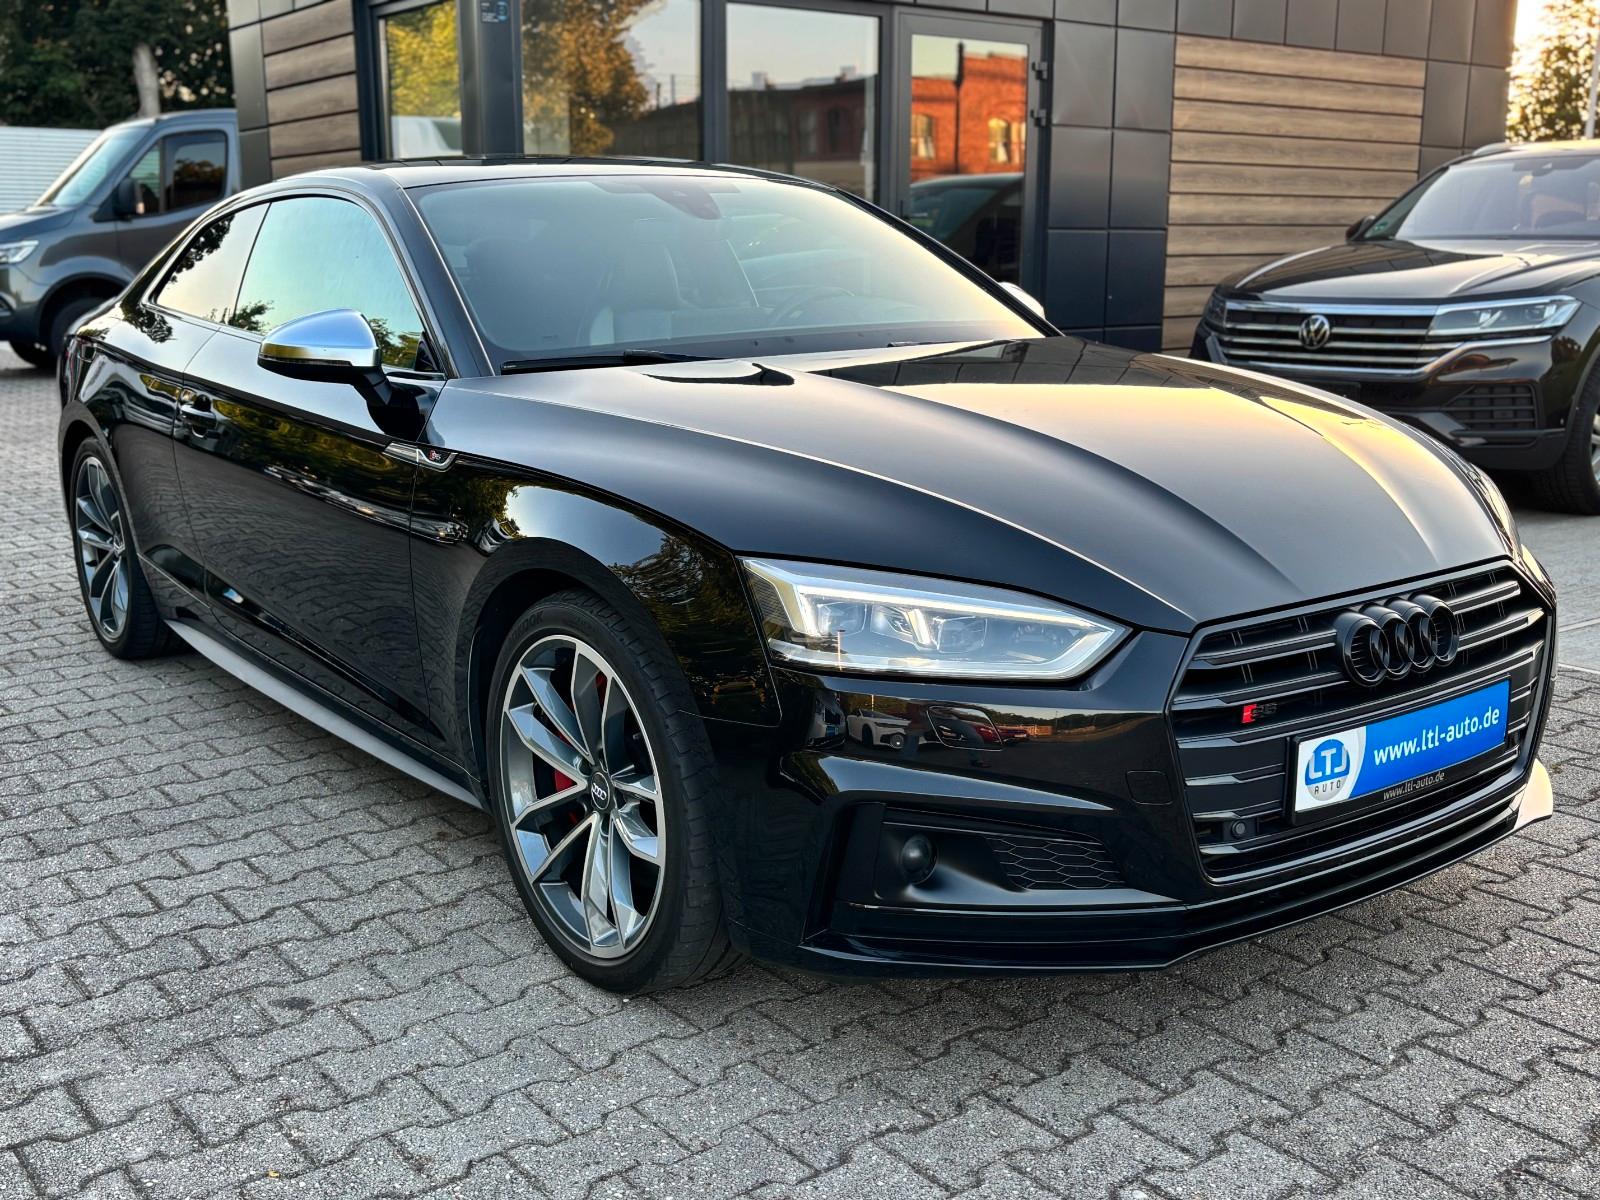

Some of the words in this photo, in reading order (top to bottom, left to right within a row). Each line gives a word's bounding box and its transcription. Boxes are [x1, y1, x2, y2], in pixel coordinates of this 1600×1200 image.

[1373, 705, 1500, 766] www.ltl-auto.de
[1314, 779, 1341, 796] AUTO
[1383, 771, 1445, 801] www.ltl-auto.de
